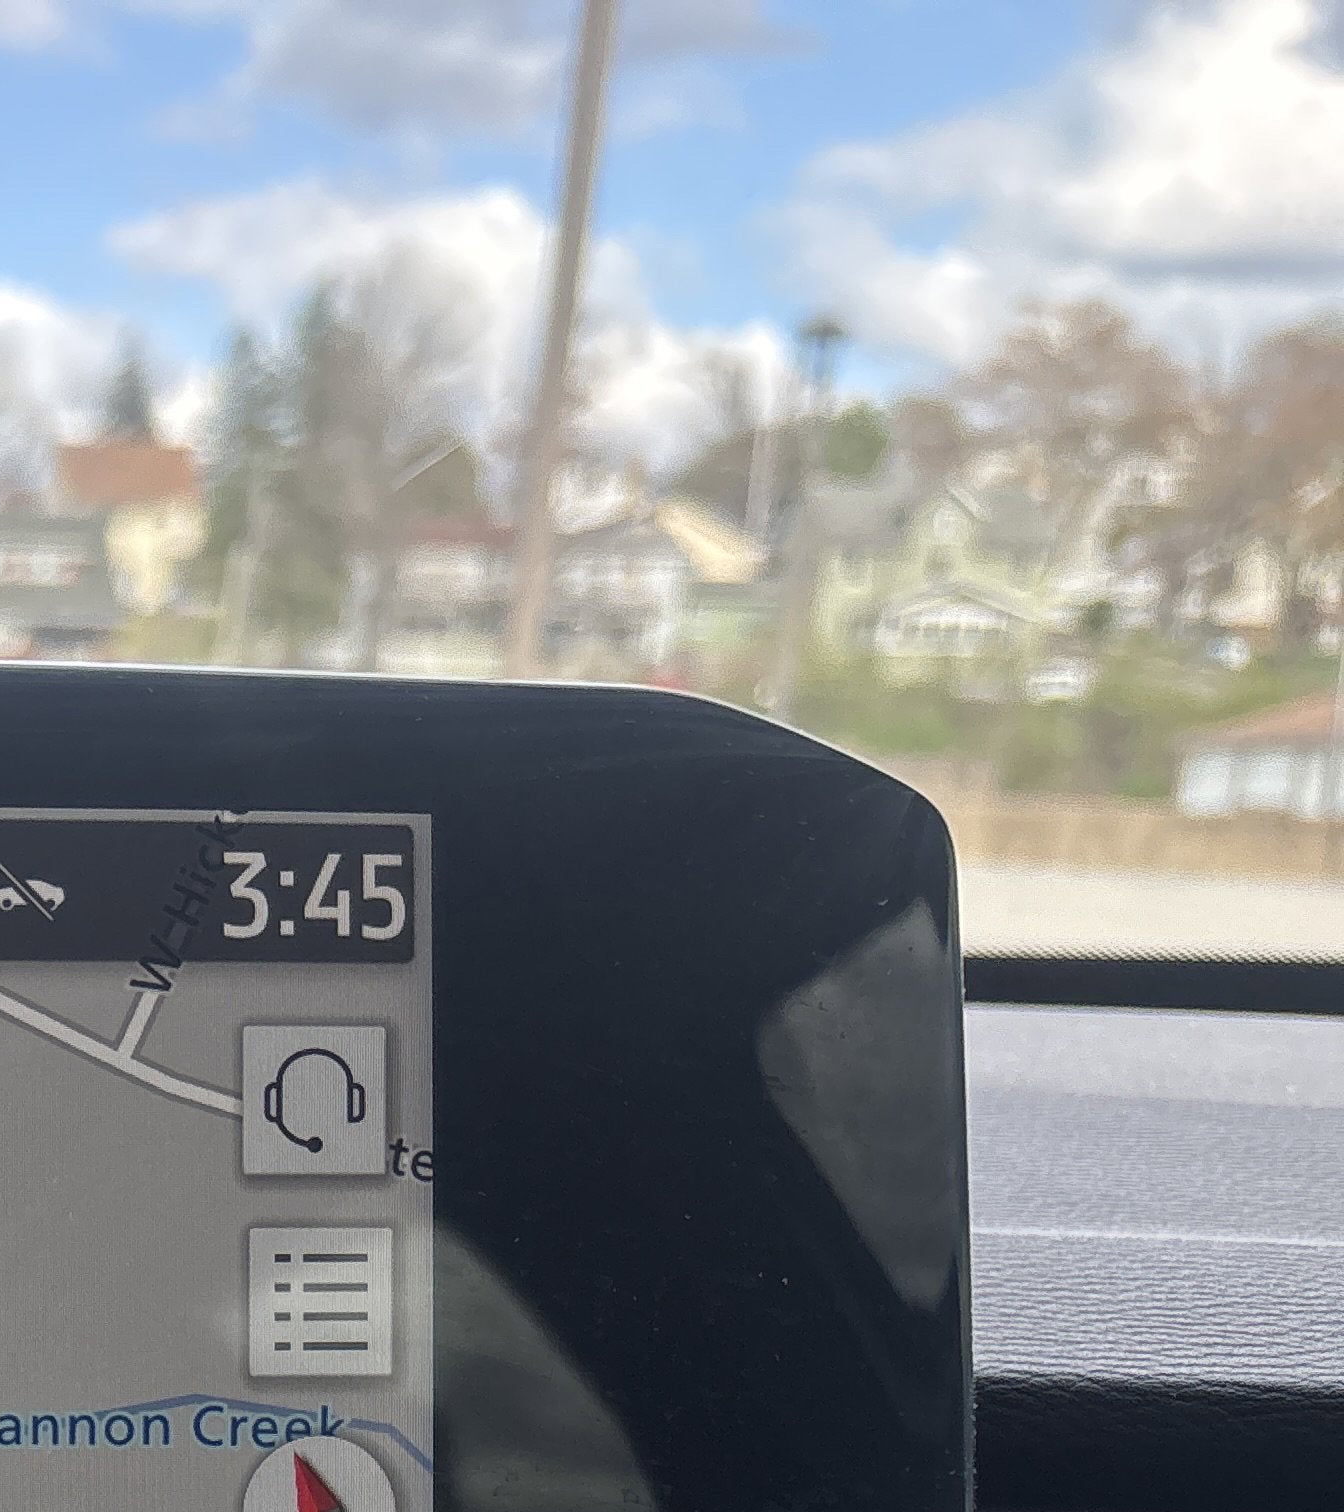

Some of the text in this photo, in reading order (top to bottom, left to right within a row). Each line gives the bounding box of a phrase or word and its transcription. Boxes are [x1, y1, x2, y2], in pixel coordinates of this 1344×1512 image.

[129, 810, 249, 992] W Hick
[222, 851, 407, 942] 3:45
[192, 1405, 346, 1448] Creek
